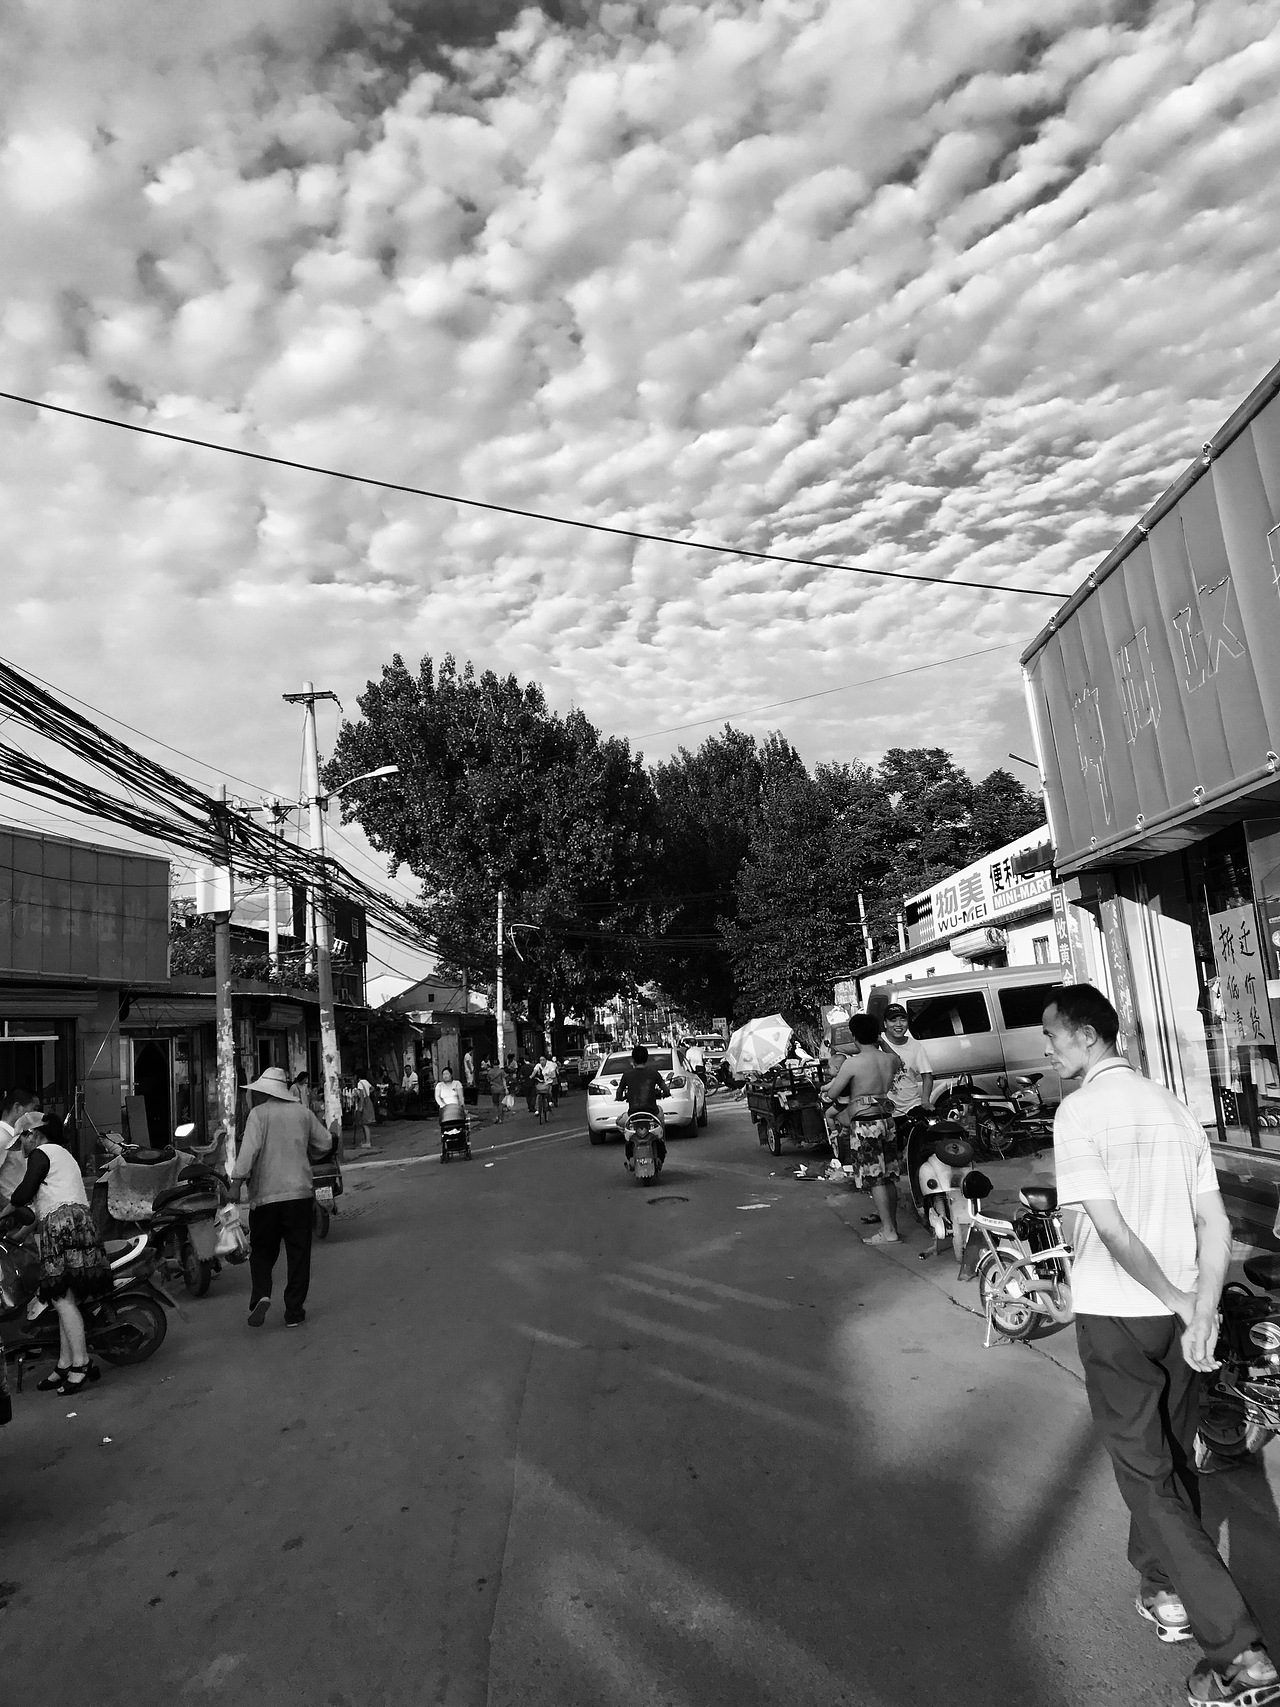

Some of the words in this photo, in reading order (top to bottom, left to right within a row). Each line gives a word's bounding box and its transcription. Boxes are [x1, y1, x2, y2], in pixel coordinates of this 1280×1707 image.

[936, 872, 985, 918] 物美
[993, 875, 1051, 909] MINI-MART
[938, 903, 987, 932] WU-MEI
[1052, 892, 1075, 987] 回收黄金
[1219, 921, 1255, 964] 拆迁
